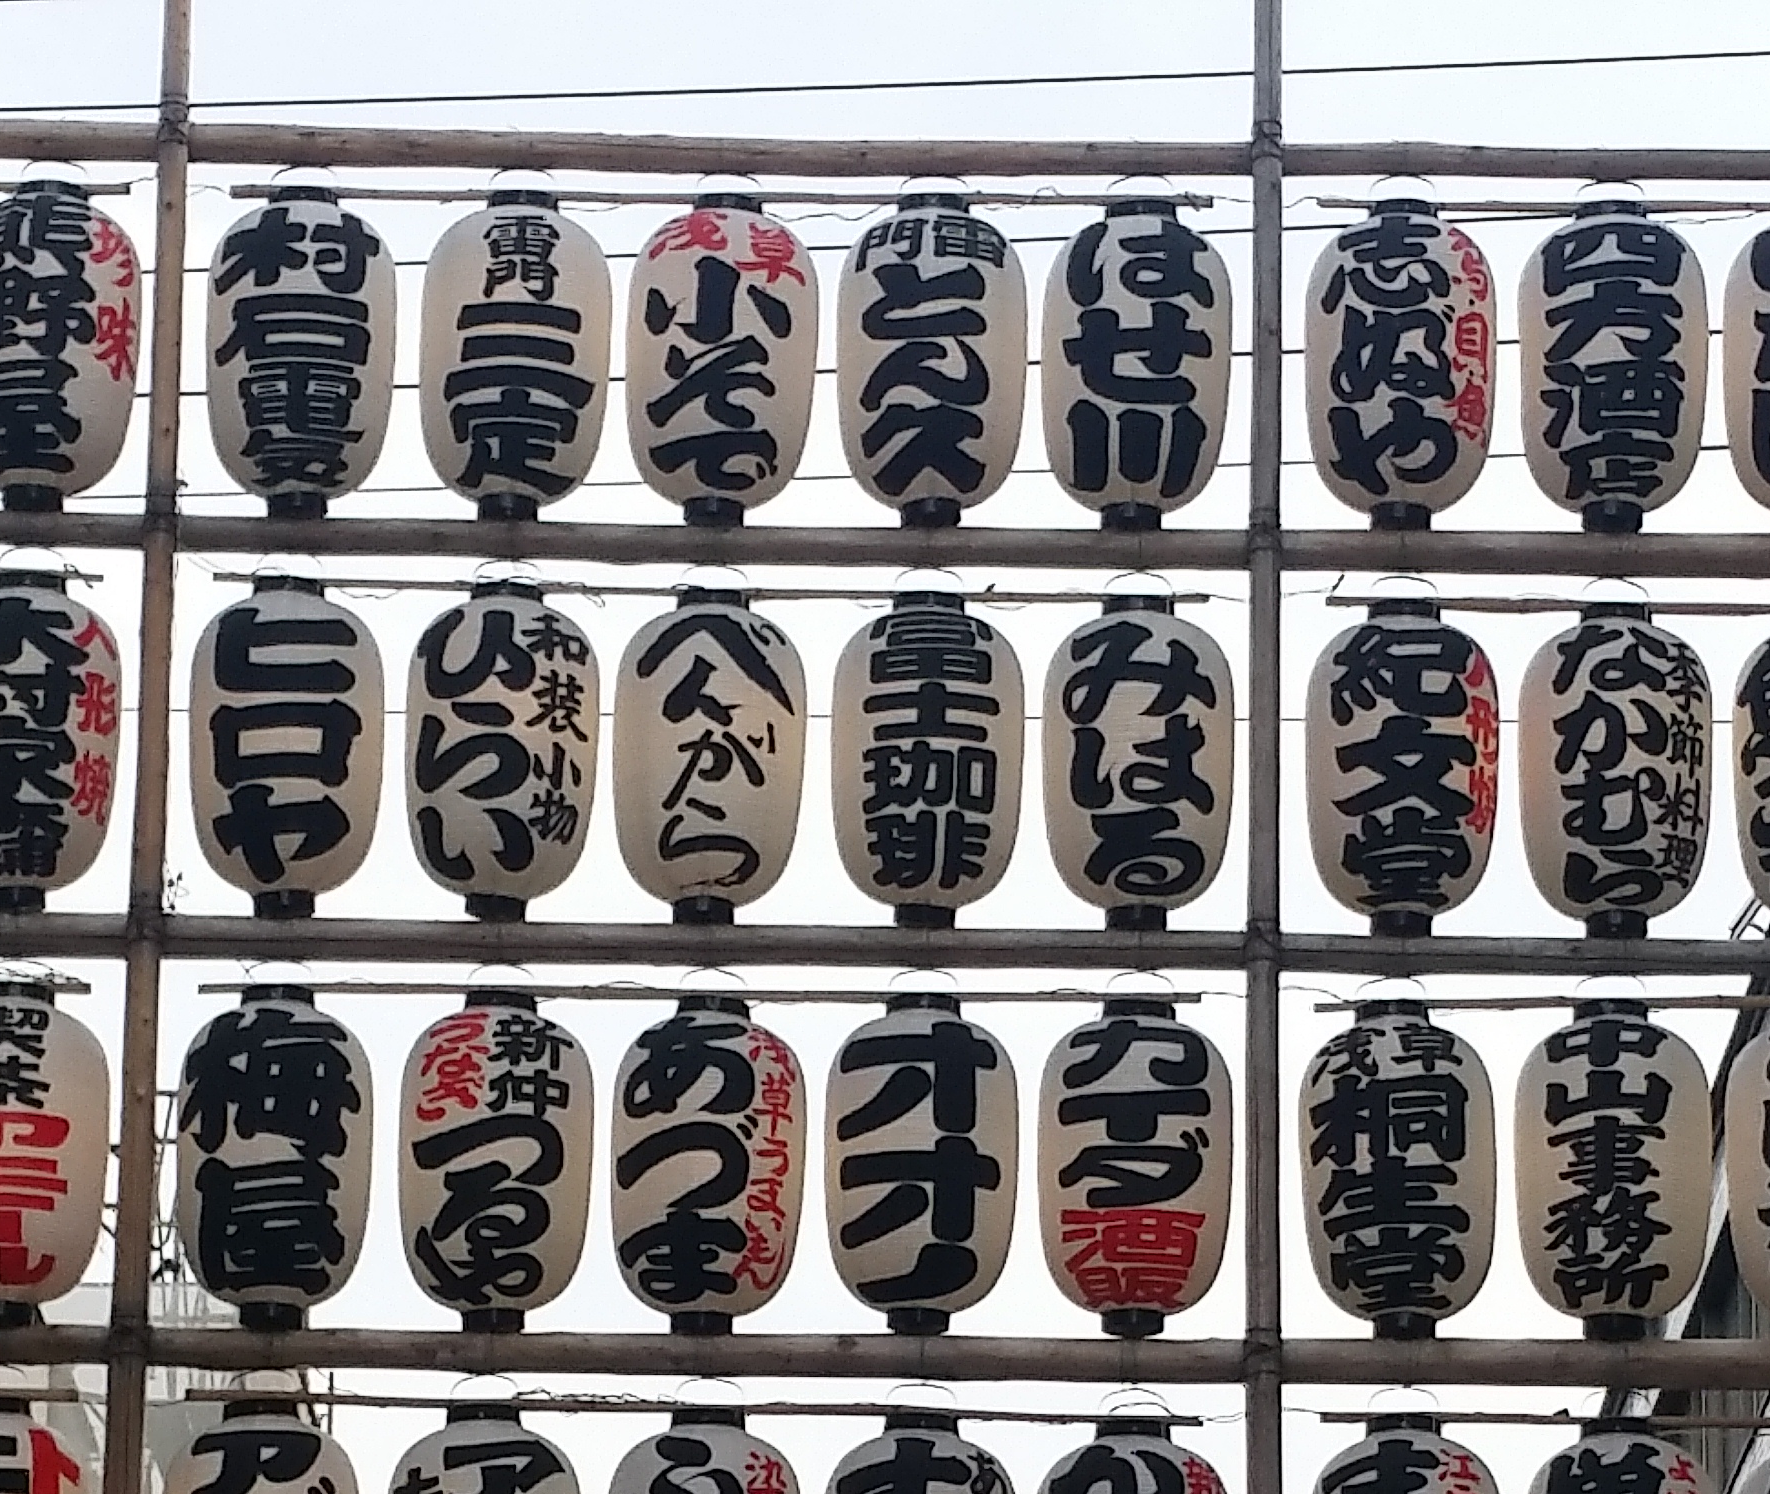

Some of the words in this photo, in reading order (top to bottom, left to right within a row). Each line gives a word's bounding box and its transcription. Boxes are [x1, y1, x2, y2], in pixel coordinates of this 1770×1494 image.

[94, 227, 134, 378] 珍味
[647, 258, 792, 490] 小そで
[655, 216, 804, 284] 浅草
[861, 264, 989, 495] とん久
[1064, 223, 1215, 498] はせ川
[1542, 225, 1686, 500] 四方酒店
[73, 615, 120, 825] 人形焼
[212, 610, 363, 885] ヒロヤ
[418, 611, 537, 881] ひらい
[525, 616, 590, 847] 和装小物
[639, 616, 795, 891] べんがら
[865, 610, 1000, 890] 富士珈琲
[1065, 623, 1218, 897] みはる
[1333, 627, 1480, 908] 紀文堂
[1555, 627, 1668, 906] なかむら
[1653, 640, 1707, 890] 季節料理
[489, 1016, 574, 1118] 新仲
[617, 1017, 761, 1303] あづま
[1312, 1072, 1471, 1314] 桐生堂
[1546, 1020, 1673, 1309] 中山事務所
[414, 1116, 564, 1306] つるや
